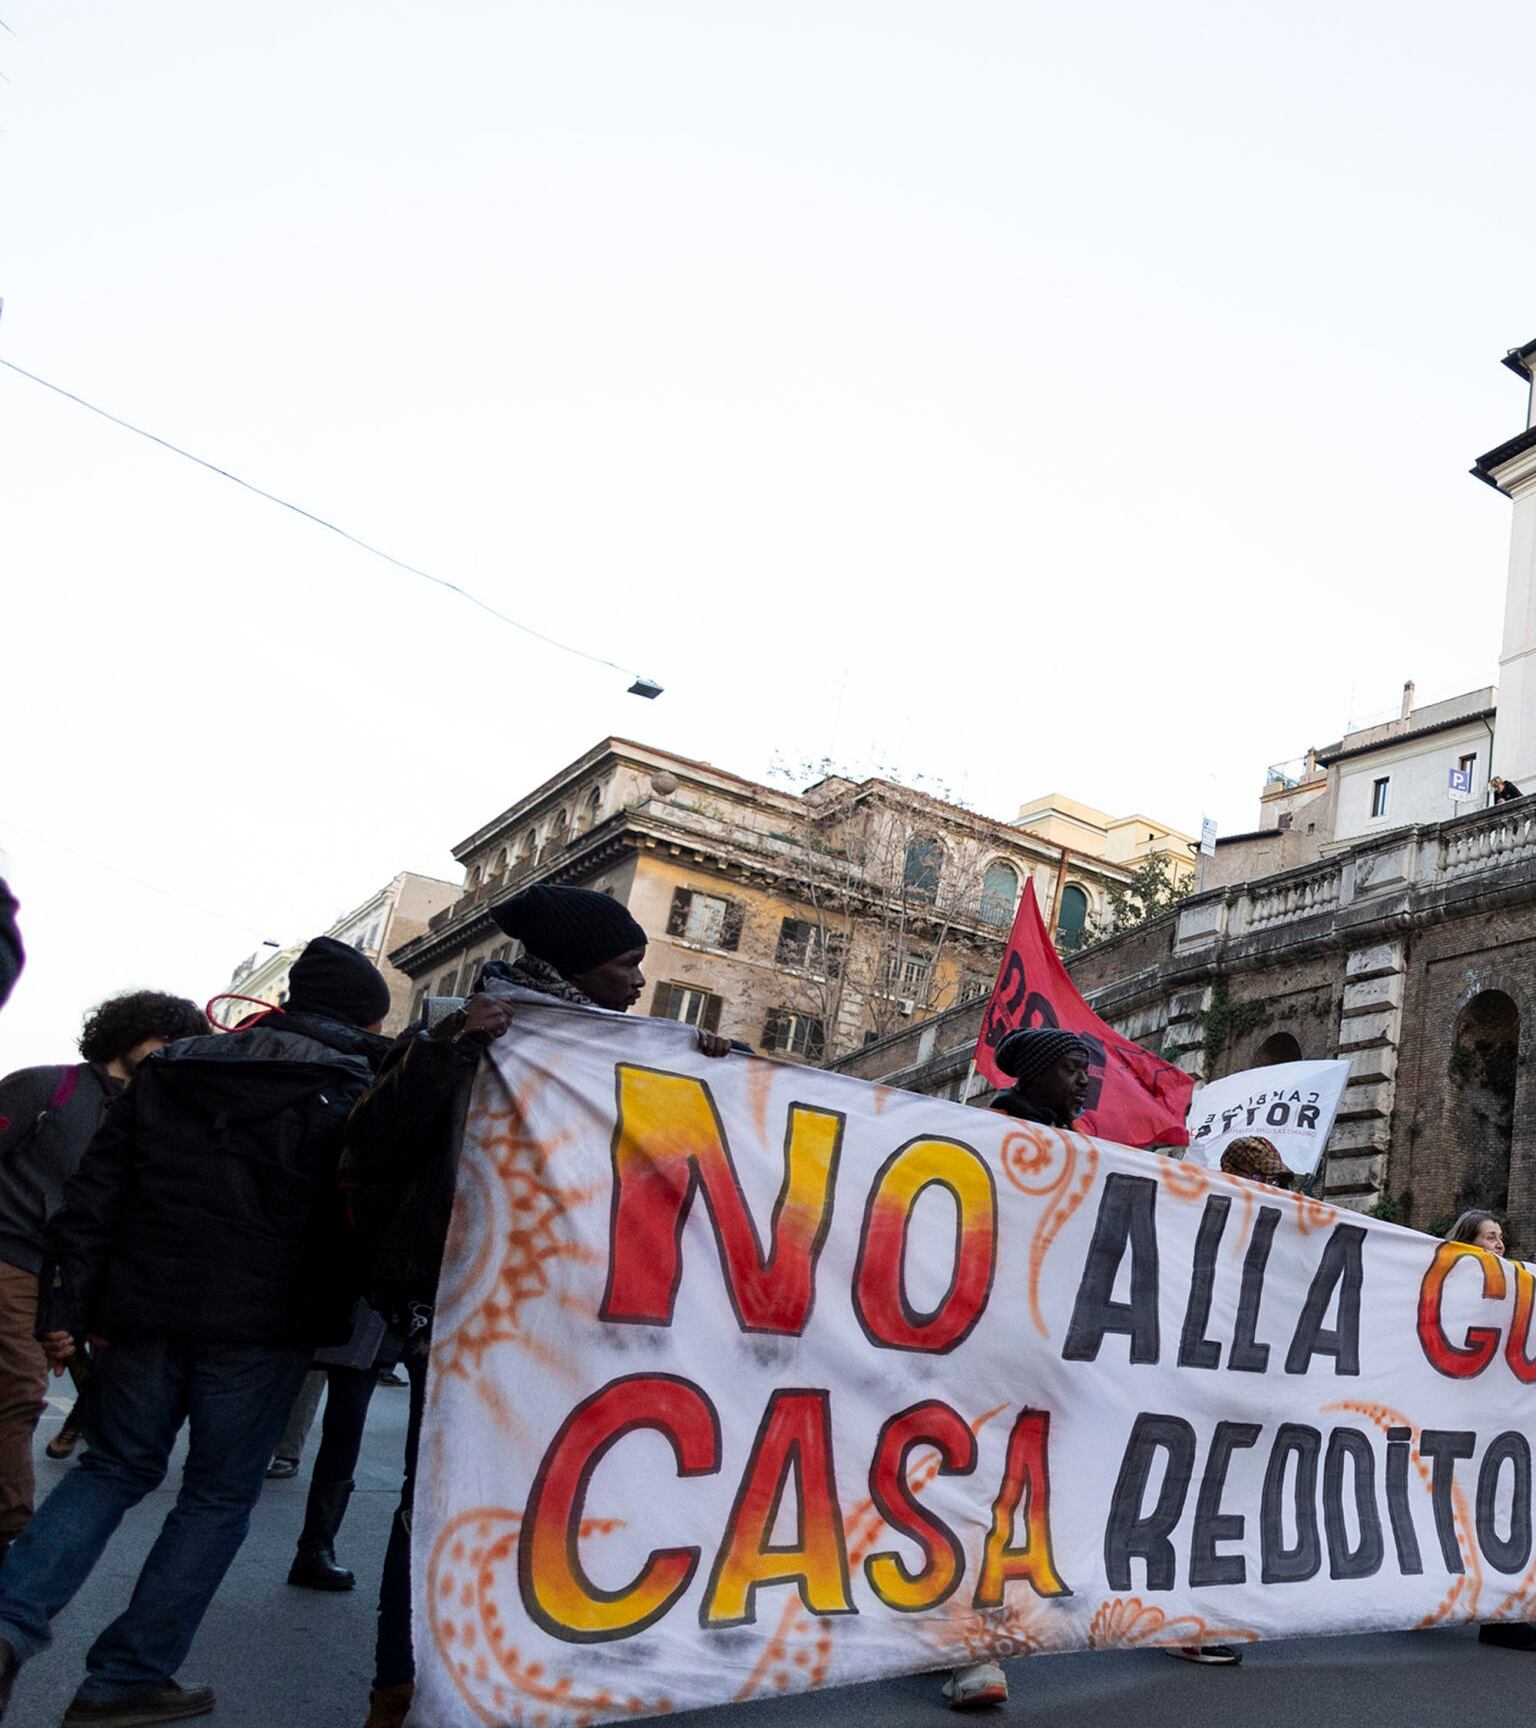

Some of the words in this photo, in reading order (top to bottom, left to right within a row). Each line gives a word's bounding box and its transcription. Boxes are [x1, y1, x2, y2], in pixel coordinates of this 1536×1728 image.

[599, 1061, 999, 1355] NO
[1062, 1172, 1368, 1377] ALLA
[517, 1372, 1074, 1644] CASA
